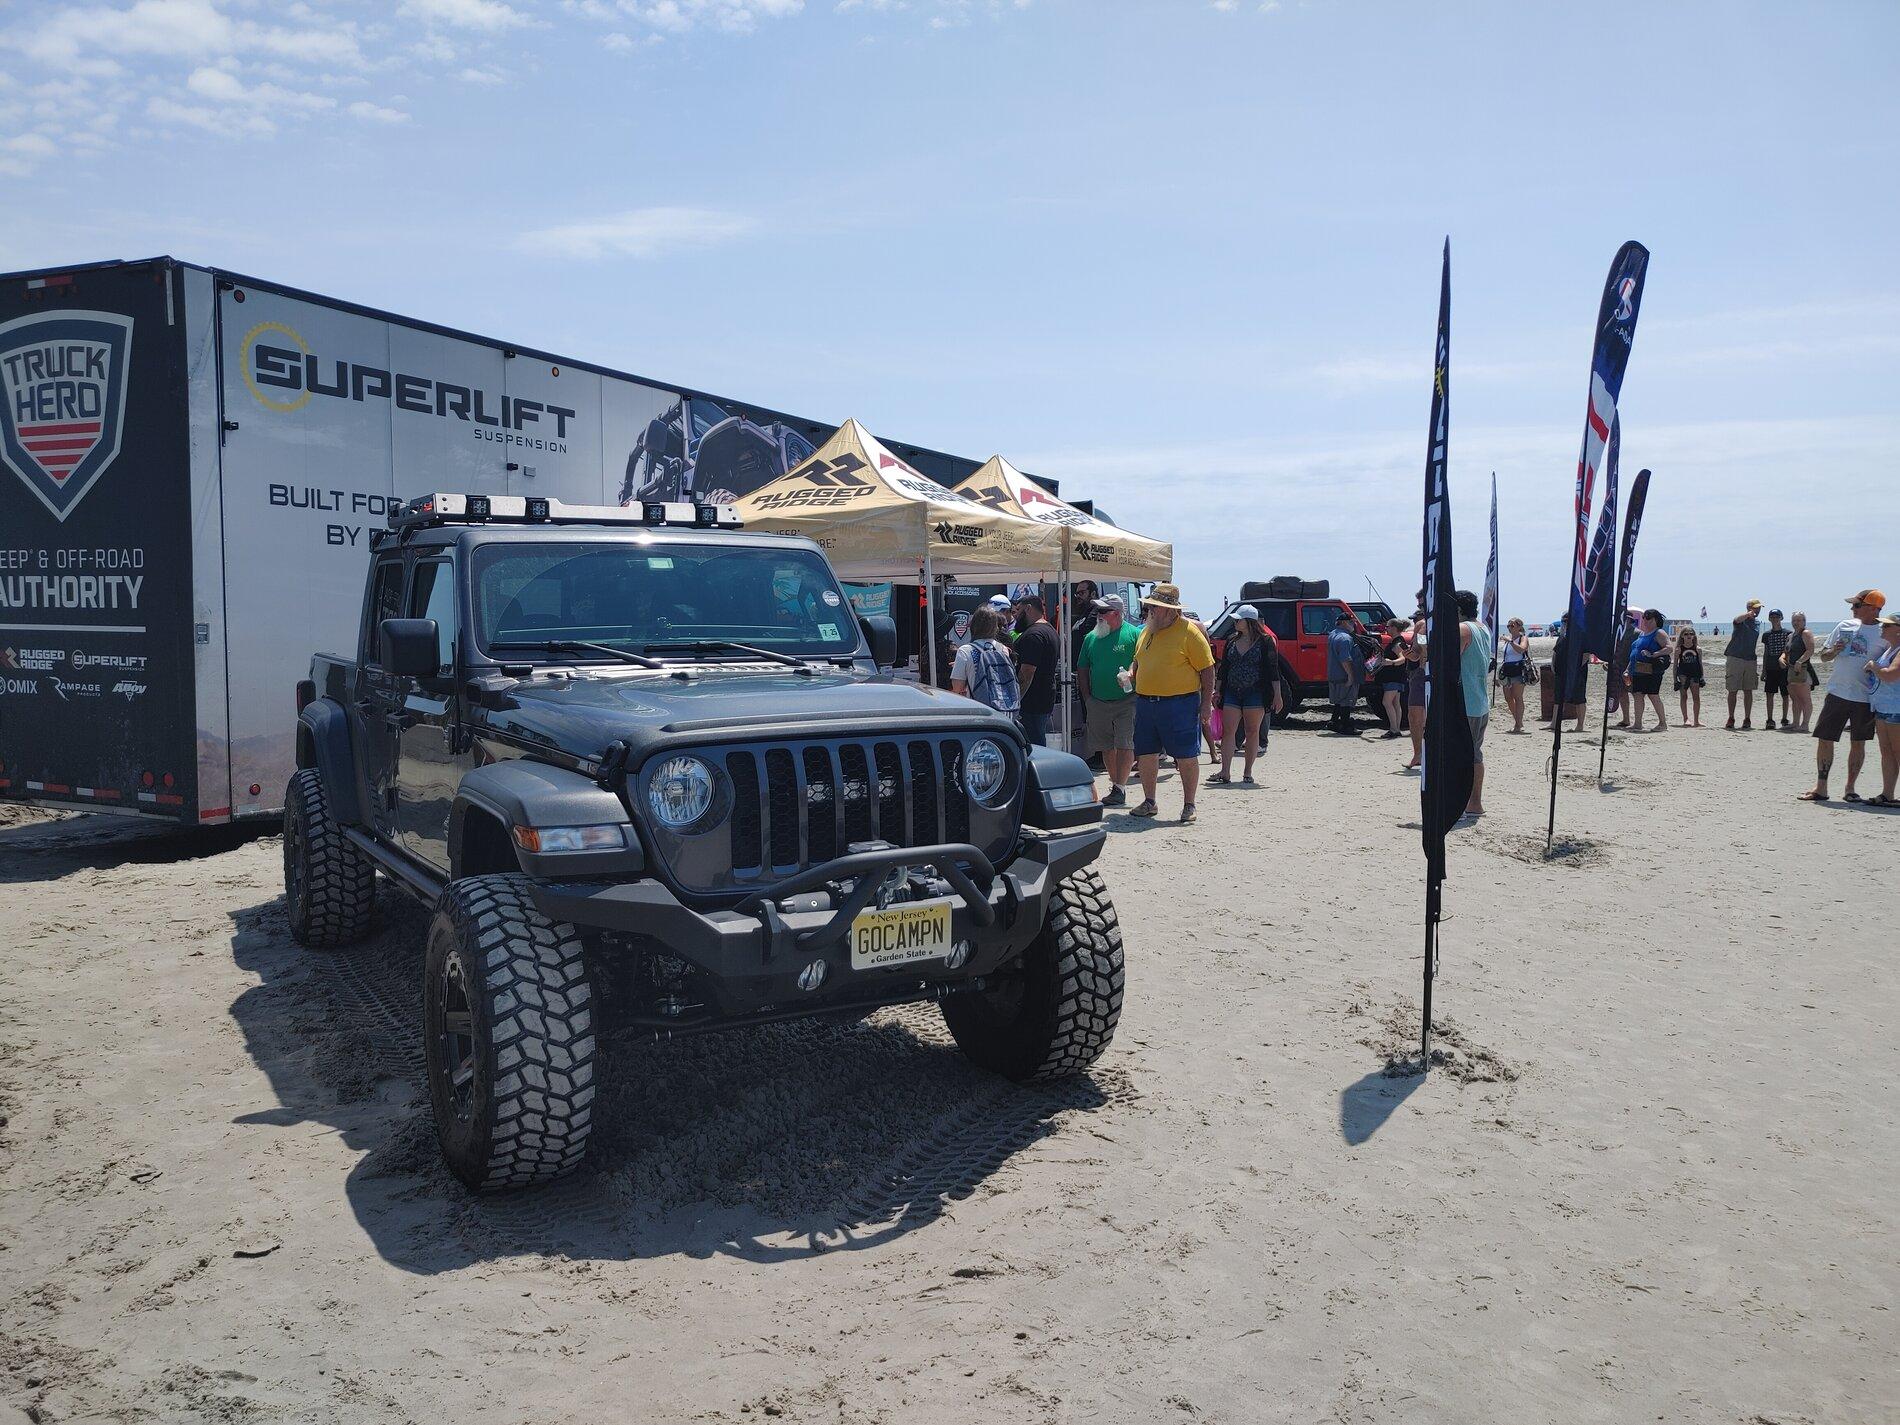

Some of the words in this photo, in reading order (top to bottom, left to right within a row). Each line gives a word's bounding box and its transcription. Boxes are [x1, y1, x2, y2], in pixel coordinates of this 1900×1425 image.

[3, 346, 107, 385] TRUCK
[256, 344, 576, 438] SUPERLIFT
[16, 381, 100, 422] HERO
[474, 429, 567, 454] SUSPENSION
[270, 484, 344, 511] BUILT
[751, 486, 877, 505] RUGGED
[757, 498, 853, 511] RIDGE
[327, 525, 361, 547] BY
[954, 524, 983, 537] RUGGED
[953, 535, 977, 546] RIDGE
[1091, 544, 1115, 555] RUGGED
[39, 550, 48, 568] &
[57, 549, 143, 568] OFF-ROAD
[1091, 554, 1109, 563] RIDGE
[20, 649, 65, 660] RUGGED
[73, 653, 147, 667] SUPERLIFT
[20, 660, 53, 670] RIDGE
[8, 680, 37, 694] OMIX
[876, 913, 898, 922] New
[900, 910, 927, 921] Jersey
[858, 917, 943, 954] GOCAMPN
[876, 952, 904, 963] Garden
[906, 949, 926, 959] State
